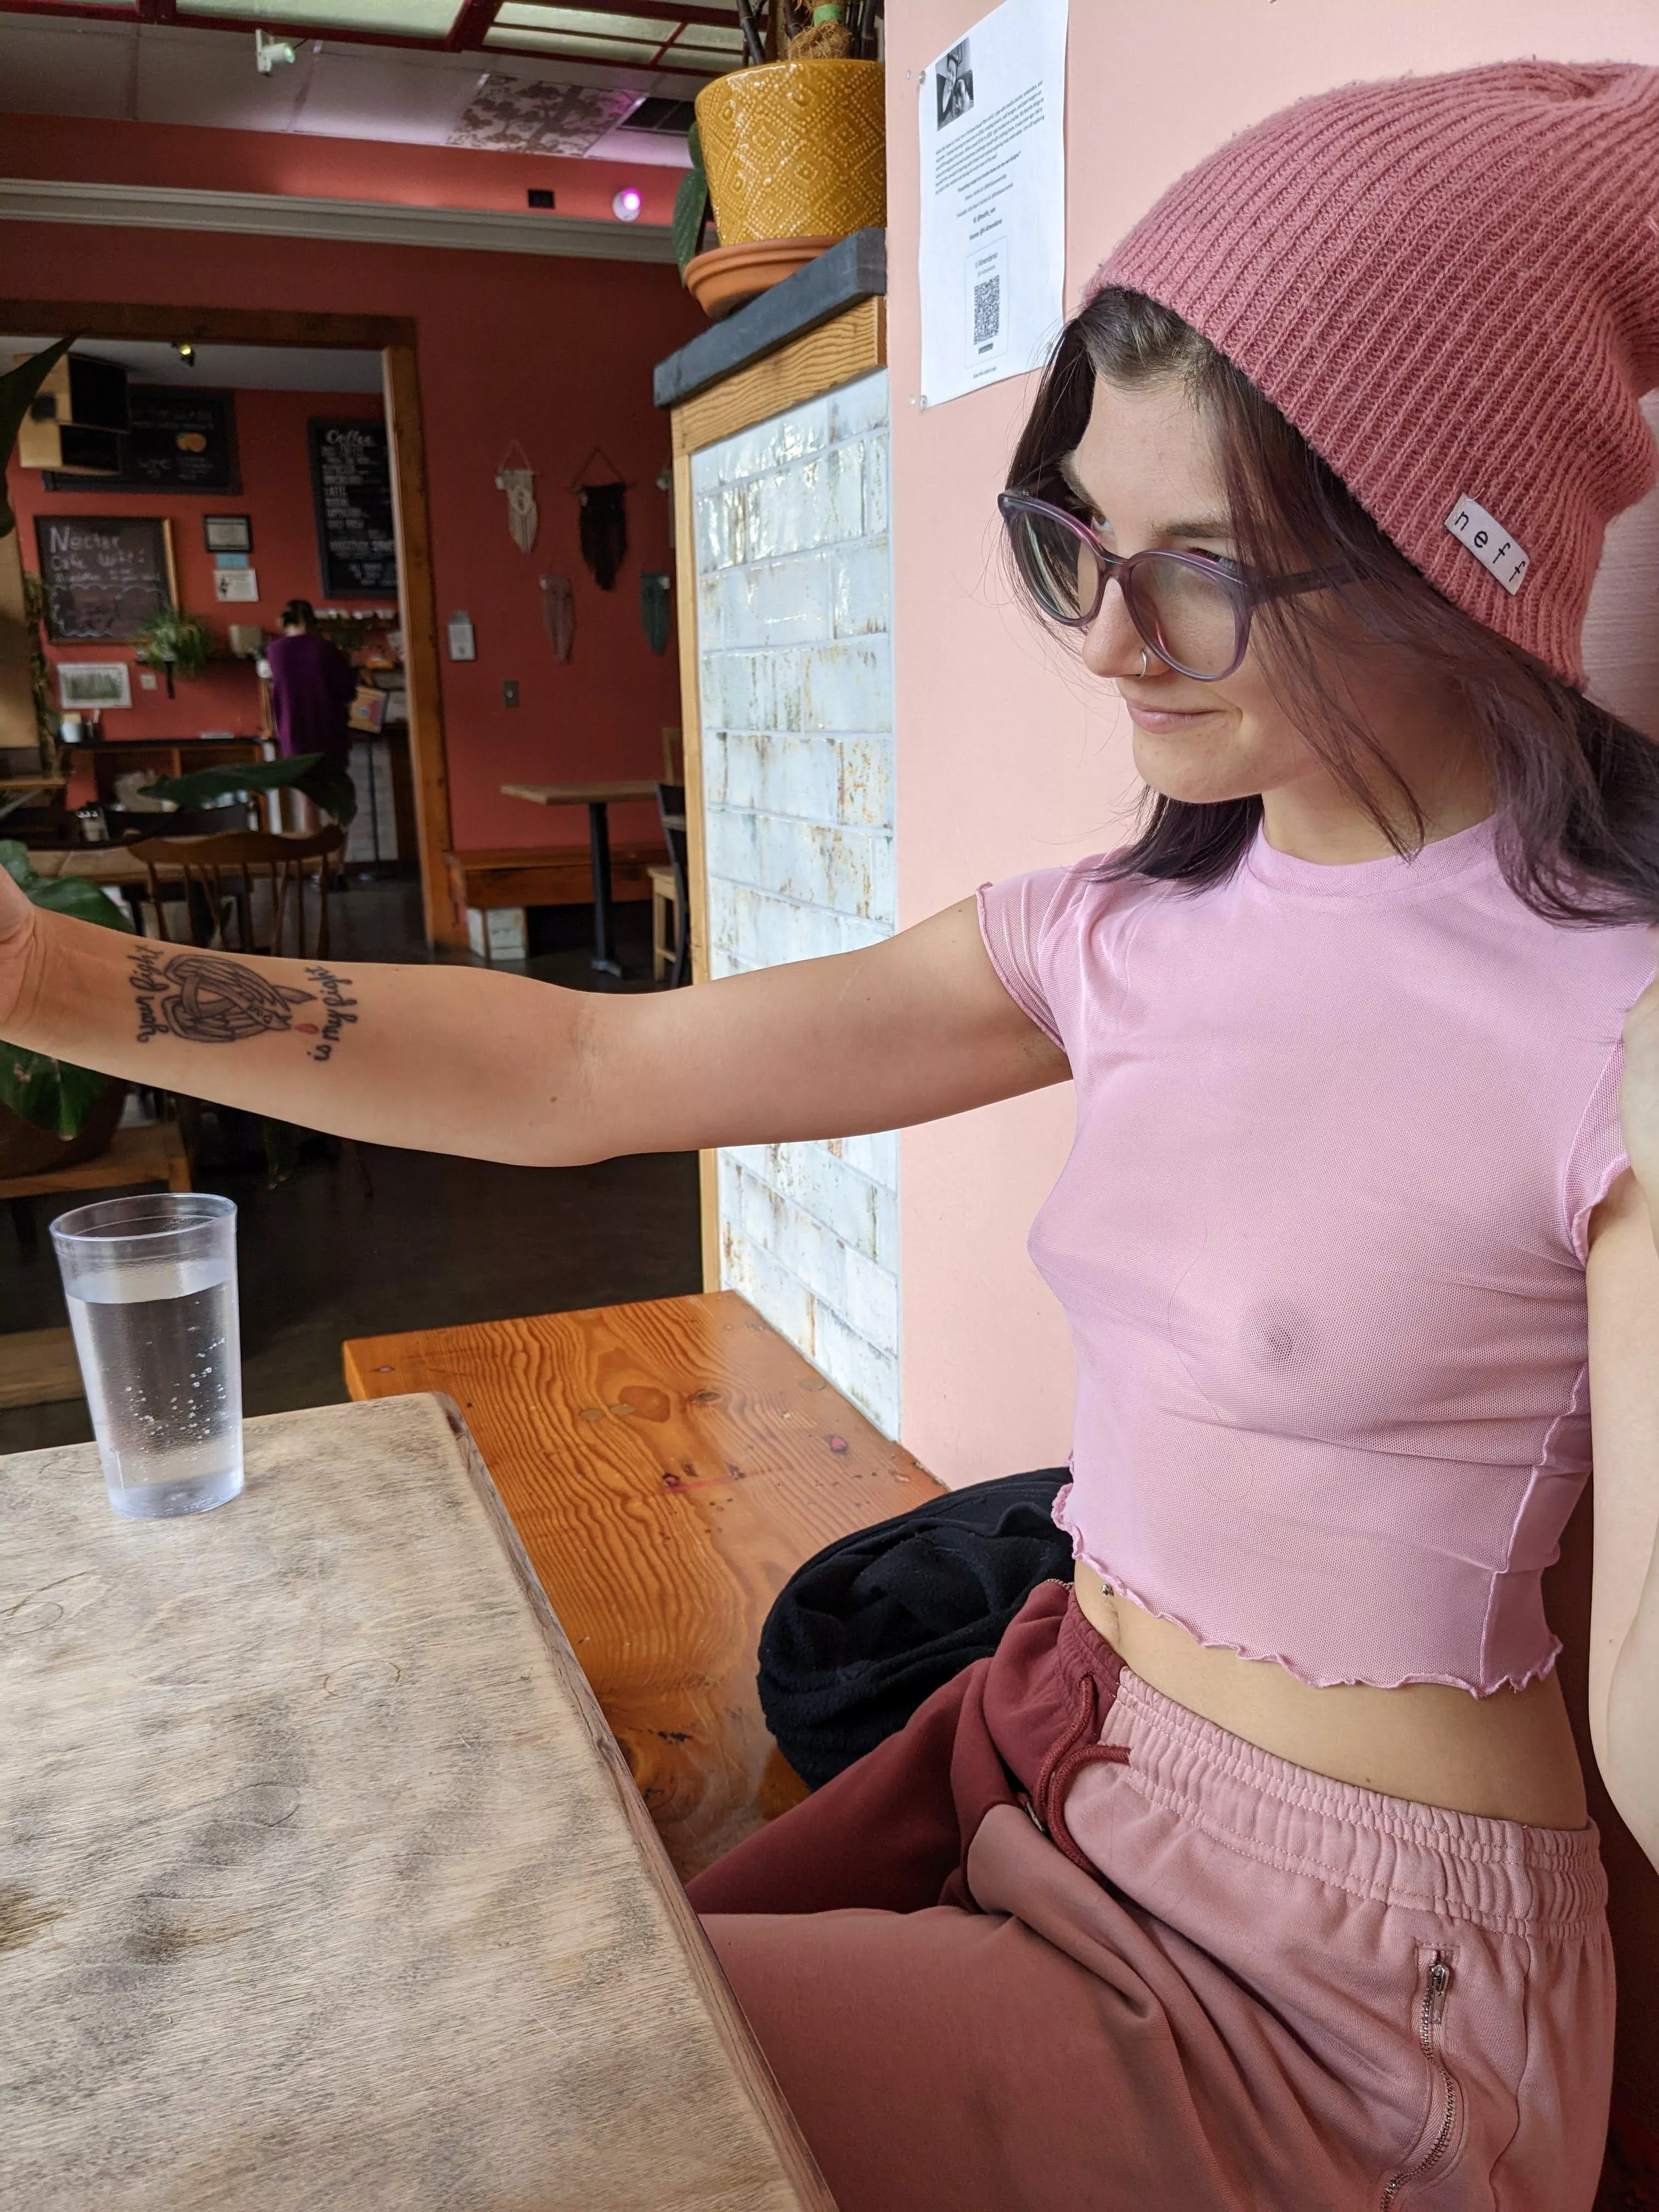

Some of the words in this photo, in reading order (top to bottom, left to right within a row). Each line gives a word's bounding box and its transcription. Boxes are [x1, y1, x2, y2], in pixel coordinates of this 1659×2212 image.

[50, 525, 120, 554] Nectar
[1454, 511, 1526, 583] neff
[127, 945, 171, 992] fight
[304, 966, 358, 1007] fight
[322, 1008, 358, 1042] my
[306, 1045, 332, 1061] is
